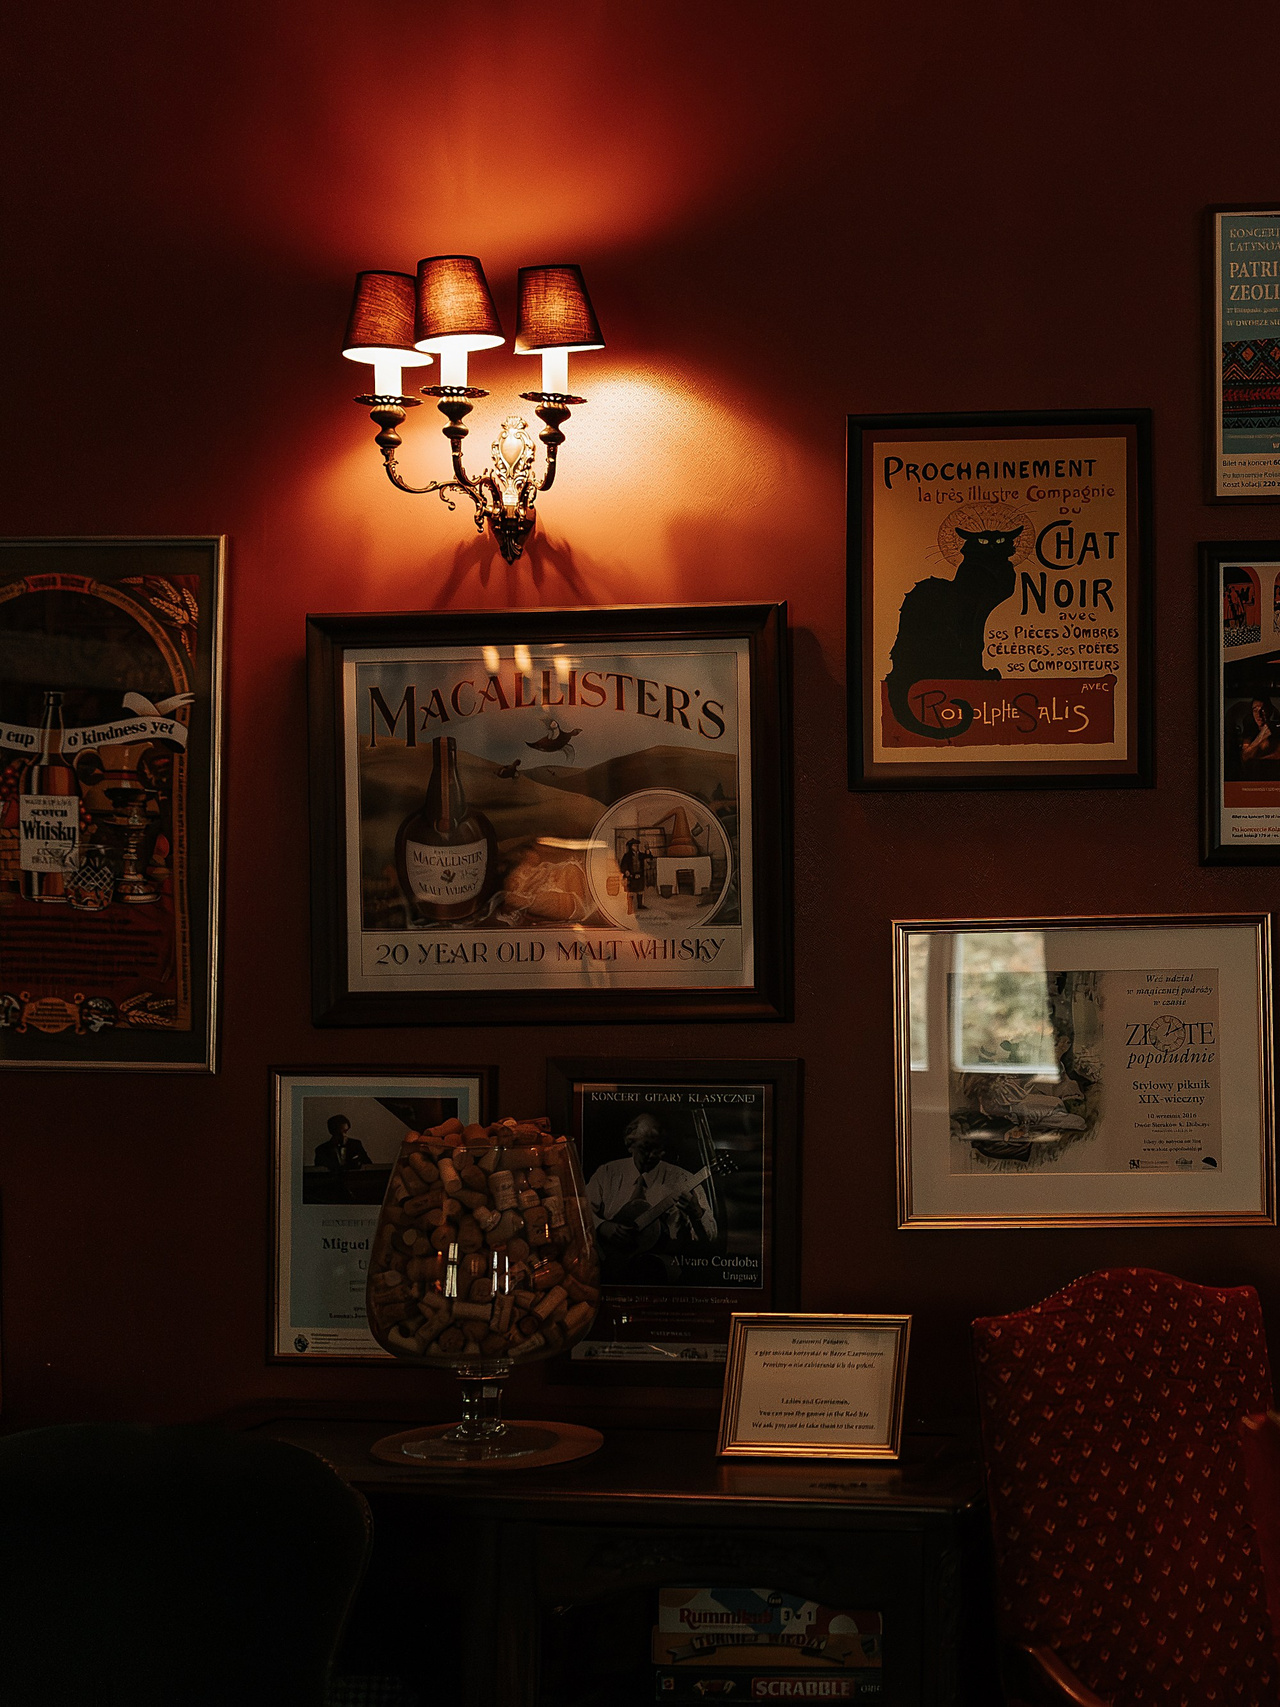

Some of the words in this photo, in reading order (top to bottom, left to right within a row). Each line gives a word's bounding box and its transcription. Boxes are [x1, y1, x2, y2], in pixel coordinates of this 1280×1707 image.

[1230, 227, 1280, 238] KONCERT
[1229, 284, 1280, 301] ZEOLI
[884, 456, 1097, 490] PROCHAINEMENT
[918, 486, 932, 503] la
[935, 486, 964, 505] très
[968, 485, 1019, 504] illustre
[1026, 484, 1116, 503] Compagnie
[1035, 519, 1120, 571] CHAT
[1020, 571, 1115, 616] NOIR
[1059, 611, 1097, 621] avec
[988, 629, 1009, 640] ses
[1057, 645, 1075, 656] ses
[1007, 661, 1026, 672] ses
[1028, 658, 1120, 673] COMPOSITEURS
[1081, 682, 1109, 693] AVEC
[367, 670, 727, 749] MACALLISTER'S
[1012, 692, 1090, 733] SALIS
[6, 731, 34, 747] cup
[82, 723, 148, 746] kindness
[150, 720, 175, 735] yet
[21, 820, 76, 845] Whisky
[375, 943, 409, 966] 20
[418, 941, 489, 967] YEAR
[496, 941, 546, 963] OLD
[557, 939, 623, 963] MALT
[631, 937, 726, 964] WHISKY
[1126, 1048, 1215, 1069] popołudnie
[1132, 1080, 1174, 1092] Stylowy
[1177, 1079, 1210, 1092] piknik
[591, 1092, 640, 1103] KONCERT
[644, 1092, 683, 1103] GITARY
[688, 1092, 756, 1104] KLASYCZNEJ
[1138, 1094, 1205, 1106] XIX-wieczny
[322, 1237, 369, 1253] Miguel
[671, 1254, 708, 1268] Alvaro
[711, 1255, 759, 1268] Cordoba
[722, 1271, 758, 1283] Uruguay
[783, 1611, 791, 1621] 3
[755, 1680, 851, 1697] SCRABBLE
